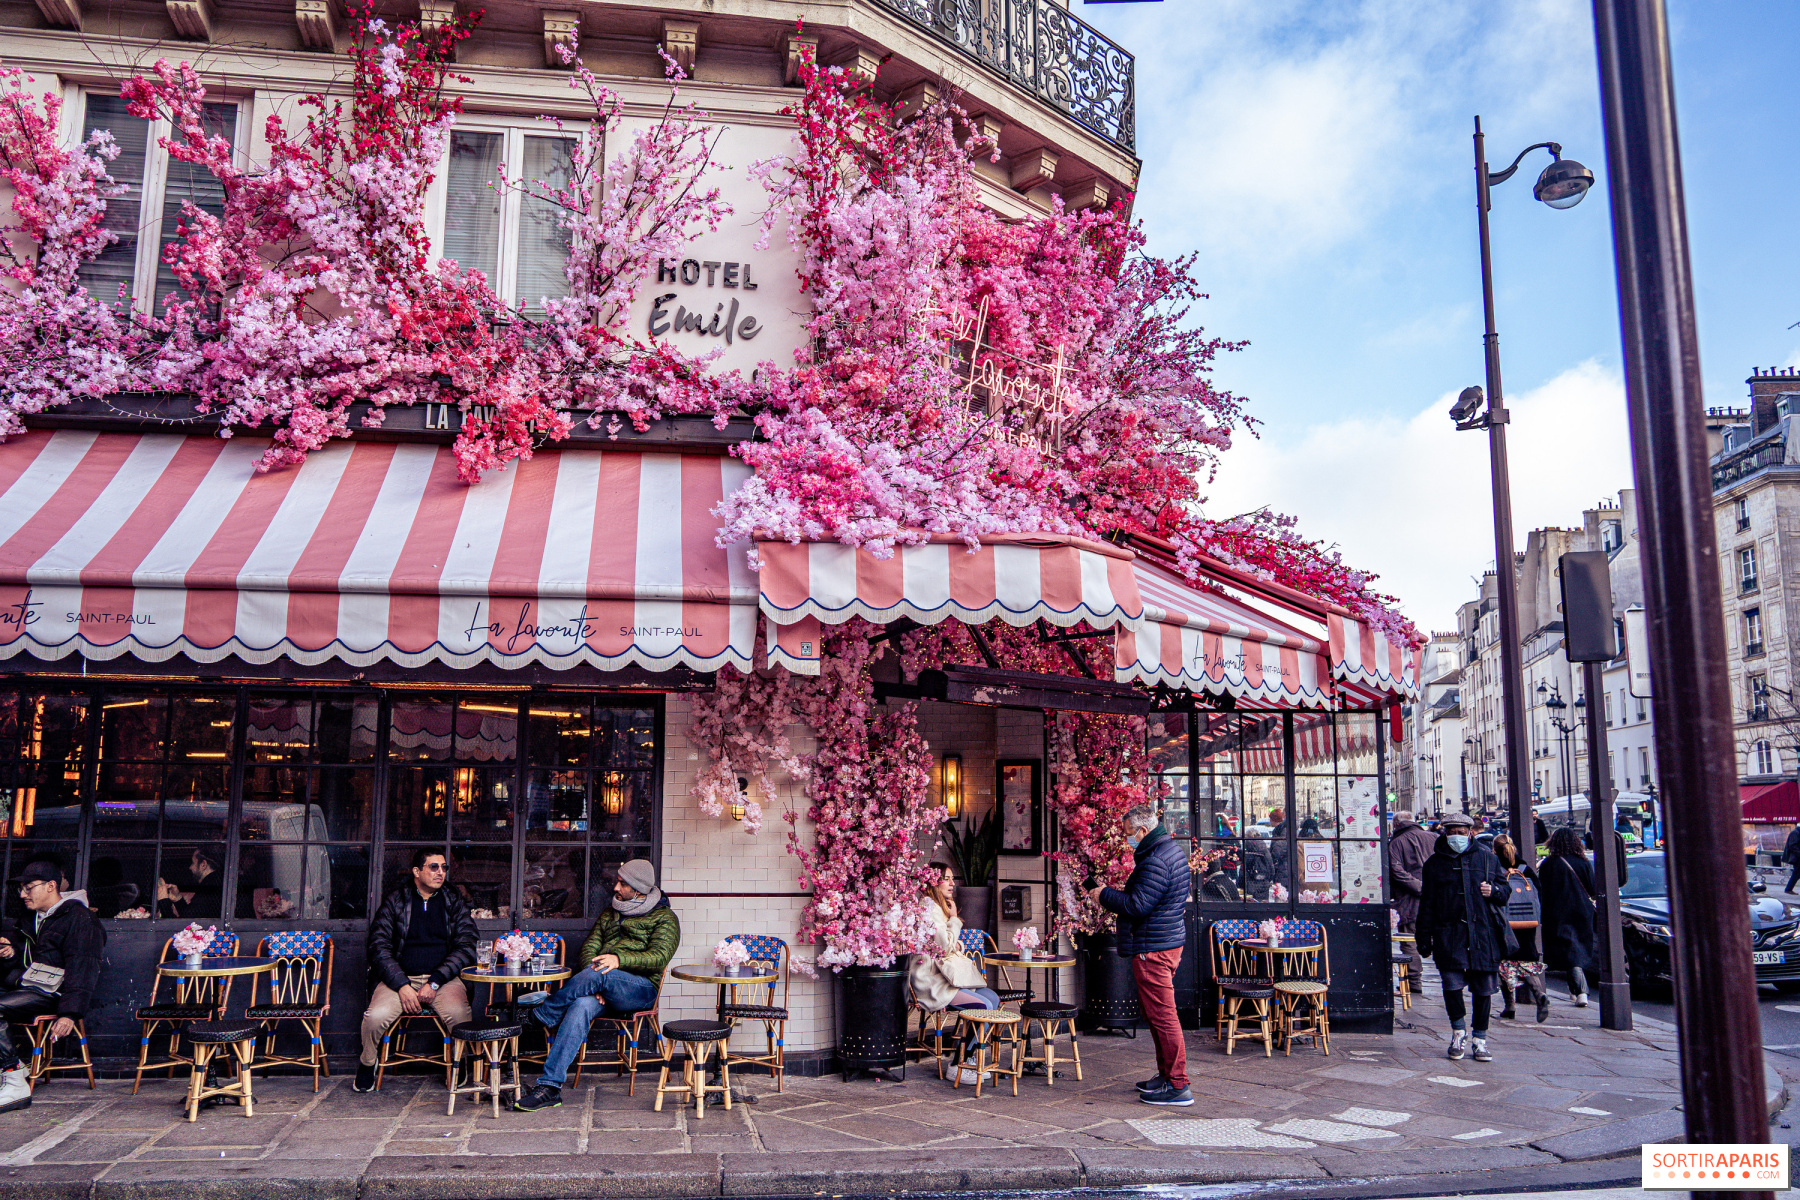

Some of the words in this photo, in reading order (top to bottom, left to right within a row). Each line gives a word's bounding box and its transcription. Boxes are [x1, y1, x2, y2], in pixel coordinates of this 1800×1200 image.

[658, 258, 758, 290] HOTEL
[649, 293, 763, 345] Emile
[426, 403, 449, 430] LA
[66, 612, 156, 625] SAINT-PAUL
[464, 602, 505, 642] La
[507, 602, 599, 651] favorite
[619, 626, 703, 637] SAINT-PAUL
[1193, 634, 1210, 670] La
[1255, 663, 1291, 676] SAINT-PAUL
